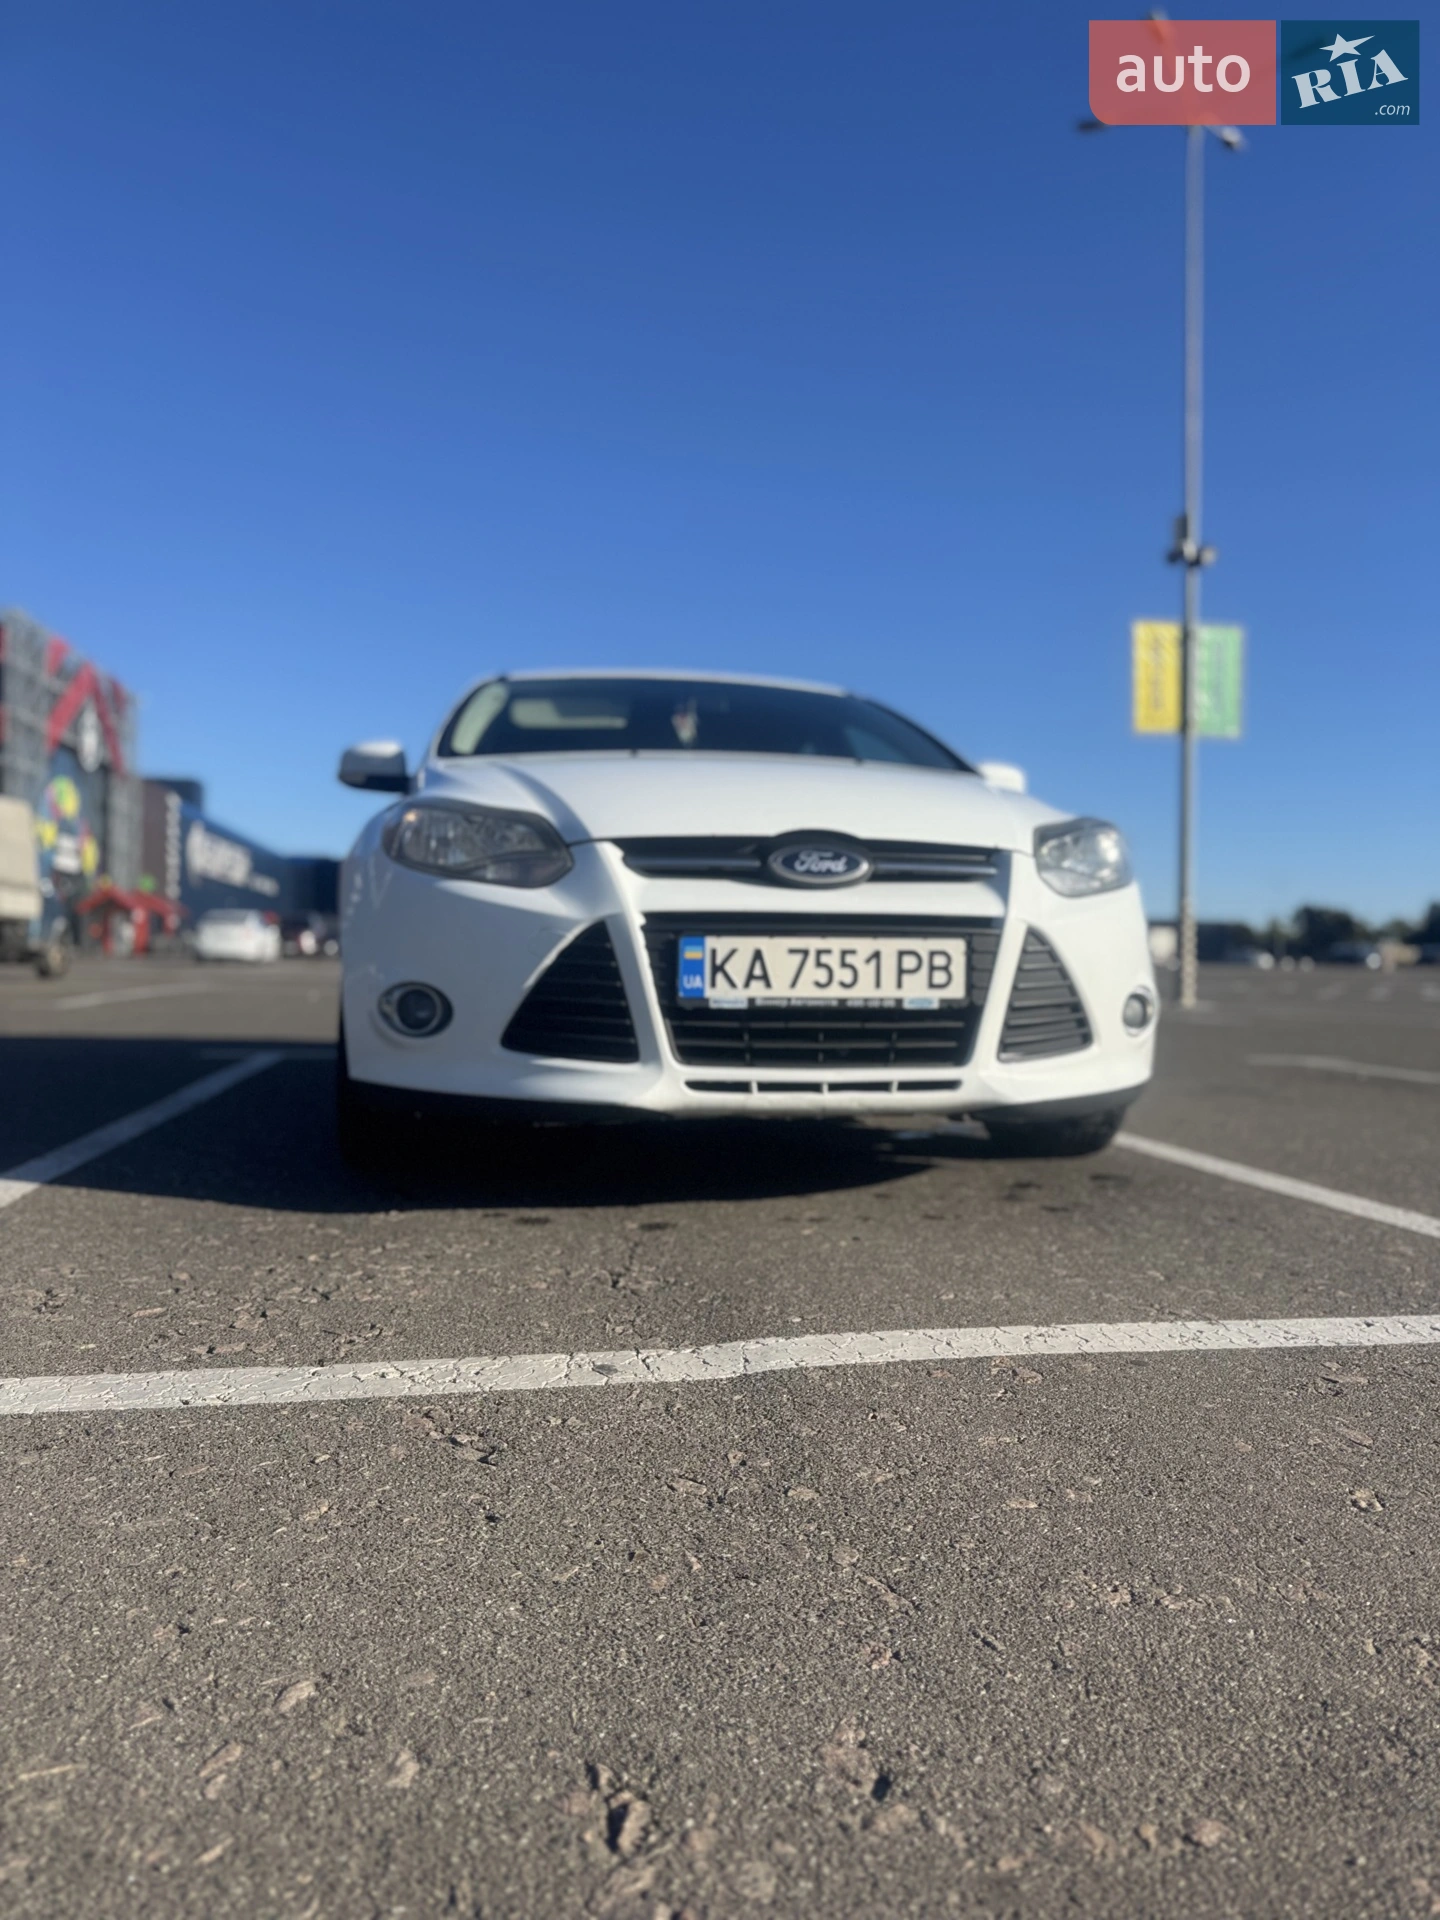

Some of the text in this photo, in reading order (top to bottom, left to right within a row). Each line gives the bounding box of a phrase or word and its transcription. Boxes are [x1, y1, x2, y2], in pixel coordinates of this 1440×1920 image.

[794, 851, 848, 873] Ford
[710, 948, 953, 990] KA 7551 PB
[682, 975, 703, 989] UA
